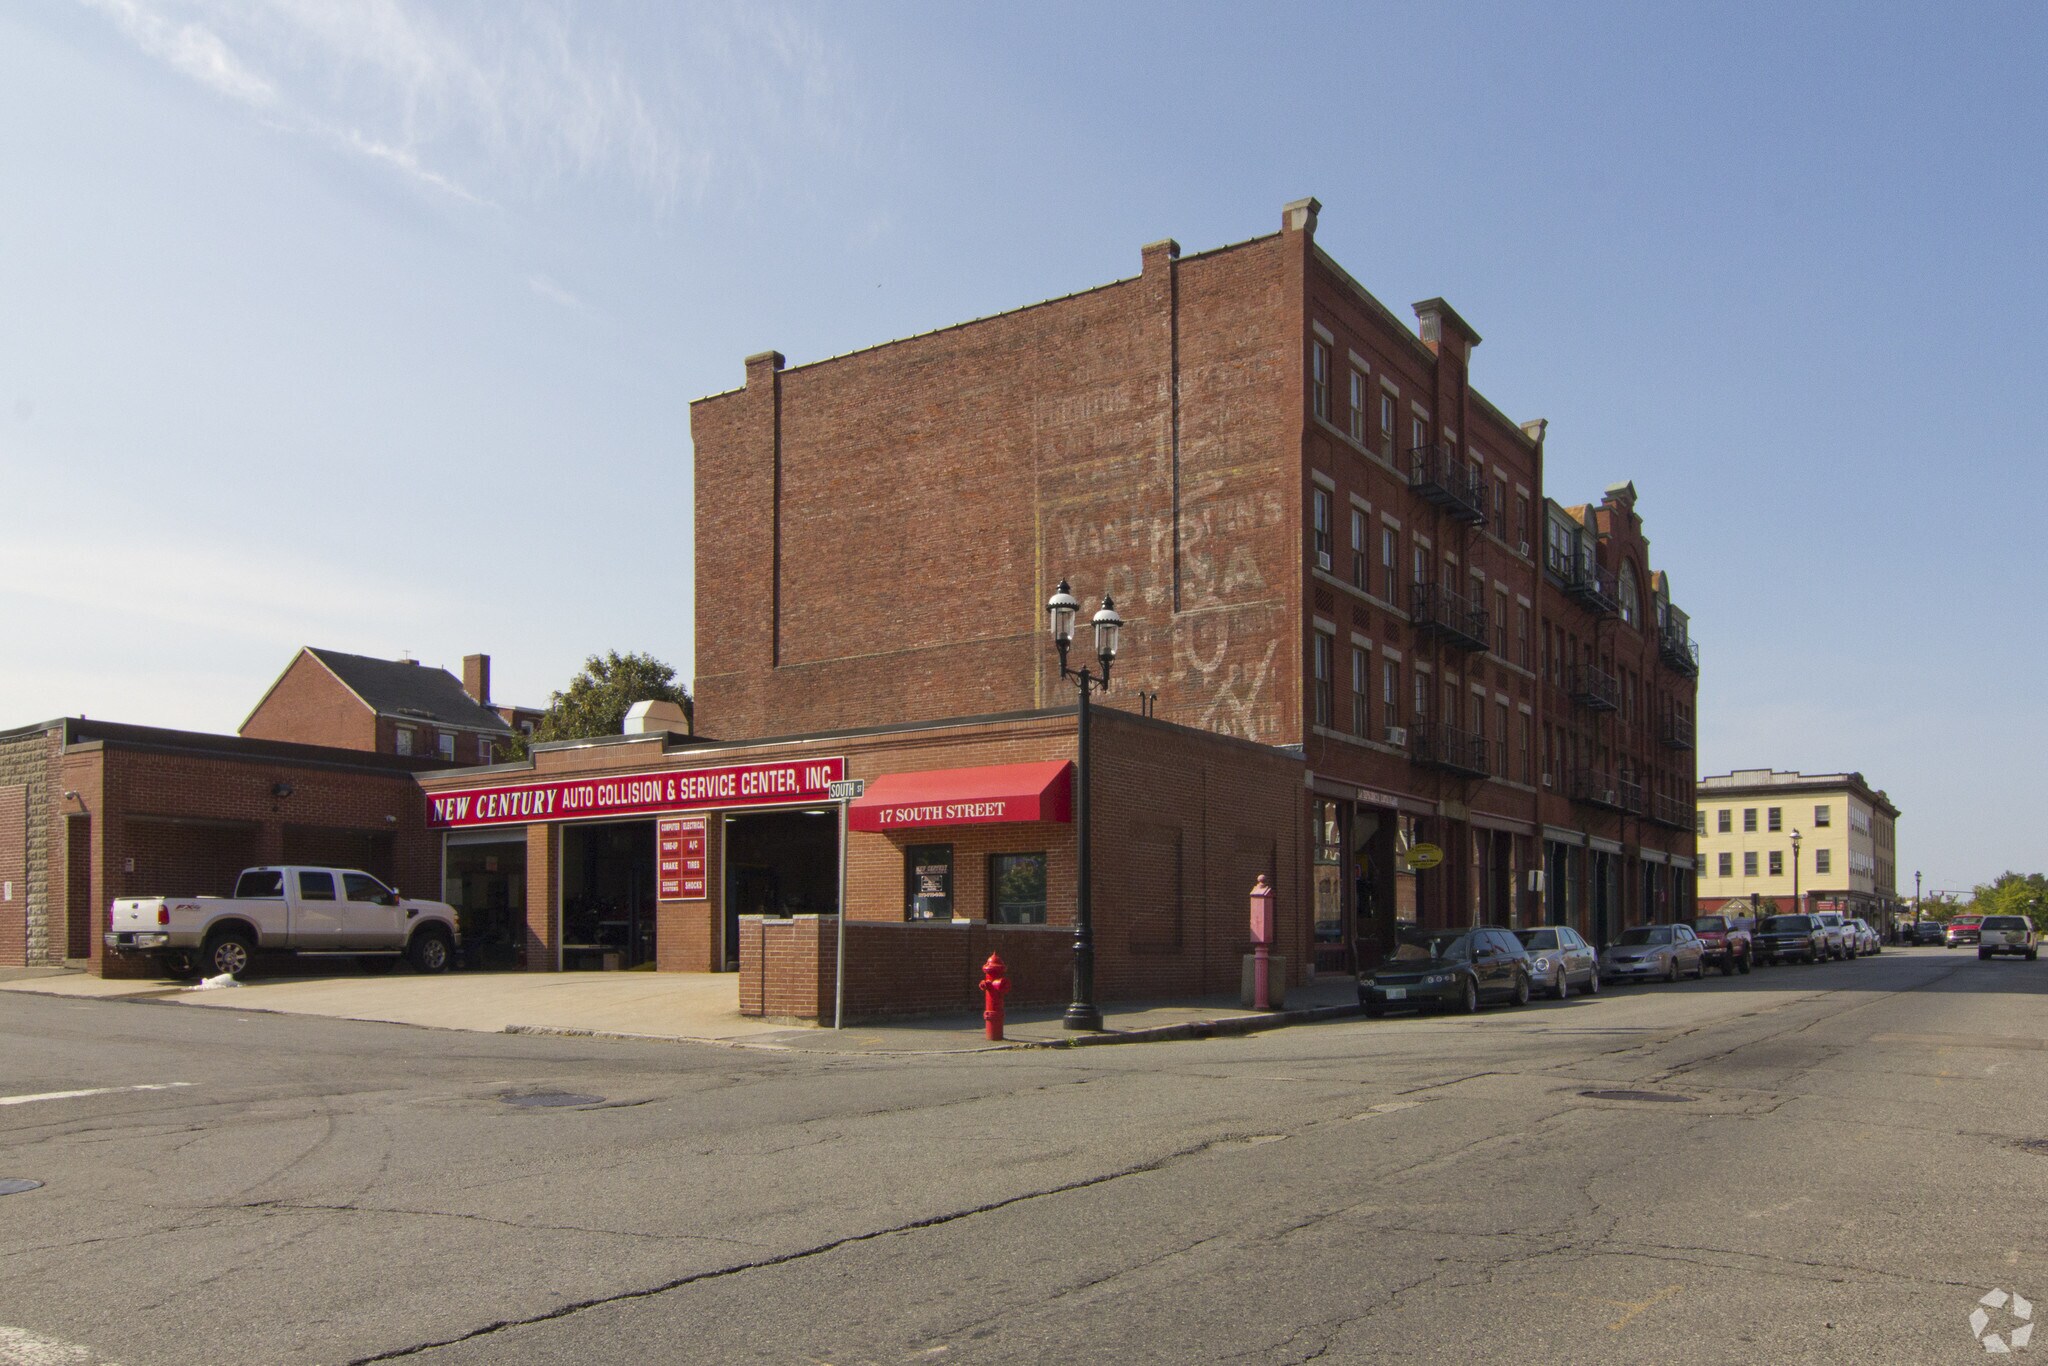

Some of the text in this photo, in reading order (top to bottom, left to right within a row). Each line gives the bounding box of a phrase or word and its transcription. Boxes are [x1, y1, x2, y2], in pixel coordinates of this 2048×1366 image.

[831, 783, 862, 798] SOUTH ST
[433, 797, 469, 822] NEW
[476, 789, 558, 817] CENTURY
[562, 785, 594, 808] AUTO
[598, 780, 662, 806] COLLISION
[667, 779, 676, 799] &
[680, 774, 736, 799] SERVICE
[741, 769, 800, 794] CENTER,
[879, 802, 1005, 823] 17 SOUTH STREET
[661, 823, 680, 831] COMPUTER
[683, 821, 704, 830] ELECTRICAL
[689, 840, 698, 850] A/C
[663, 862, 678, 870] BRAKE
[687, 861, 700, 869] TIRES
[685, 881, 702, 890] SHOCKS
